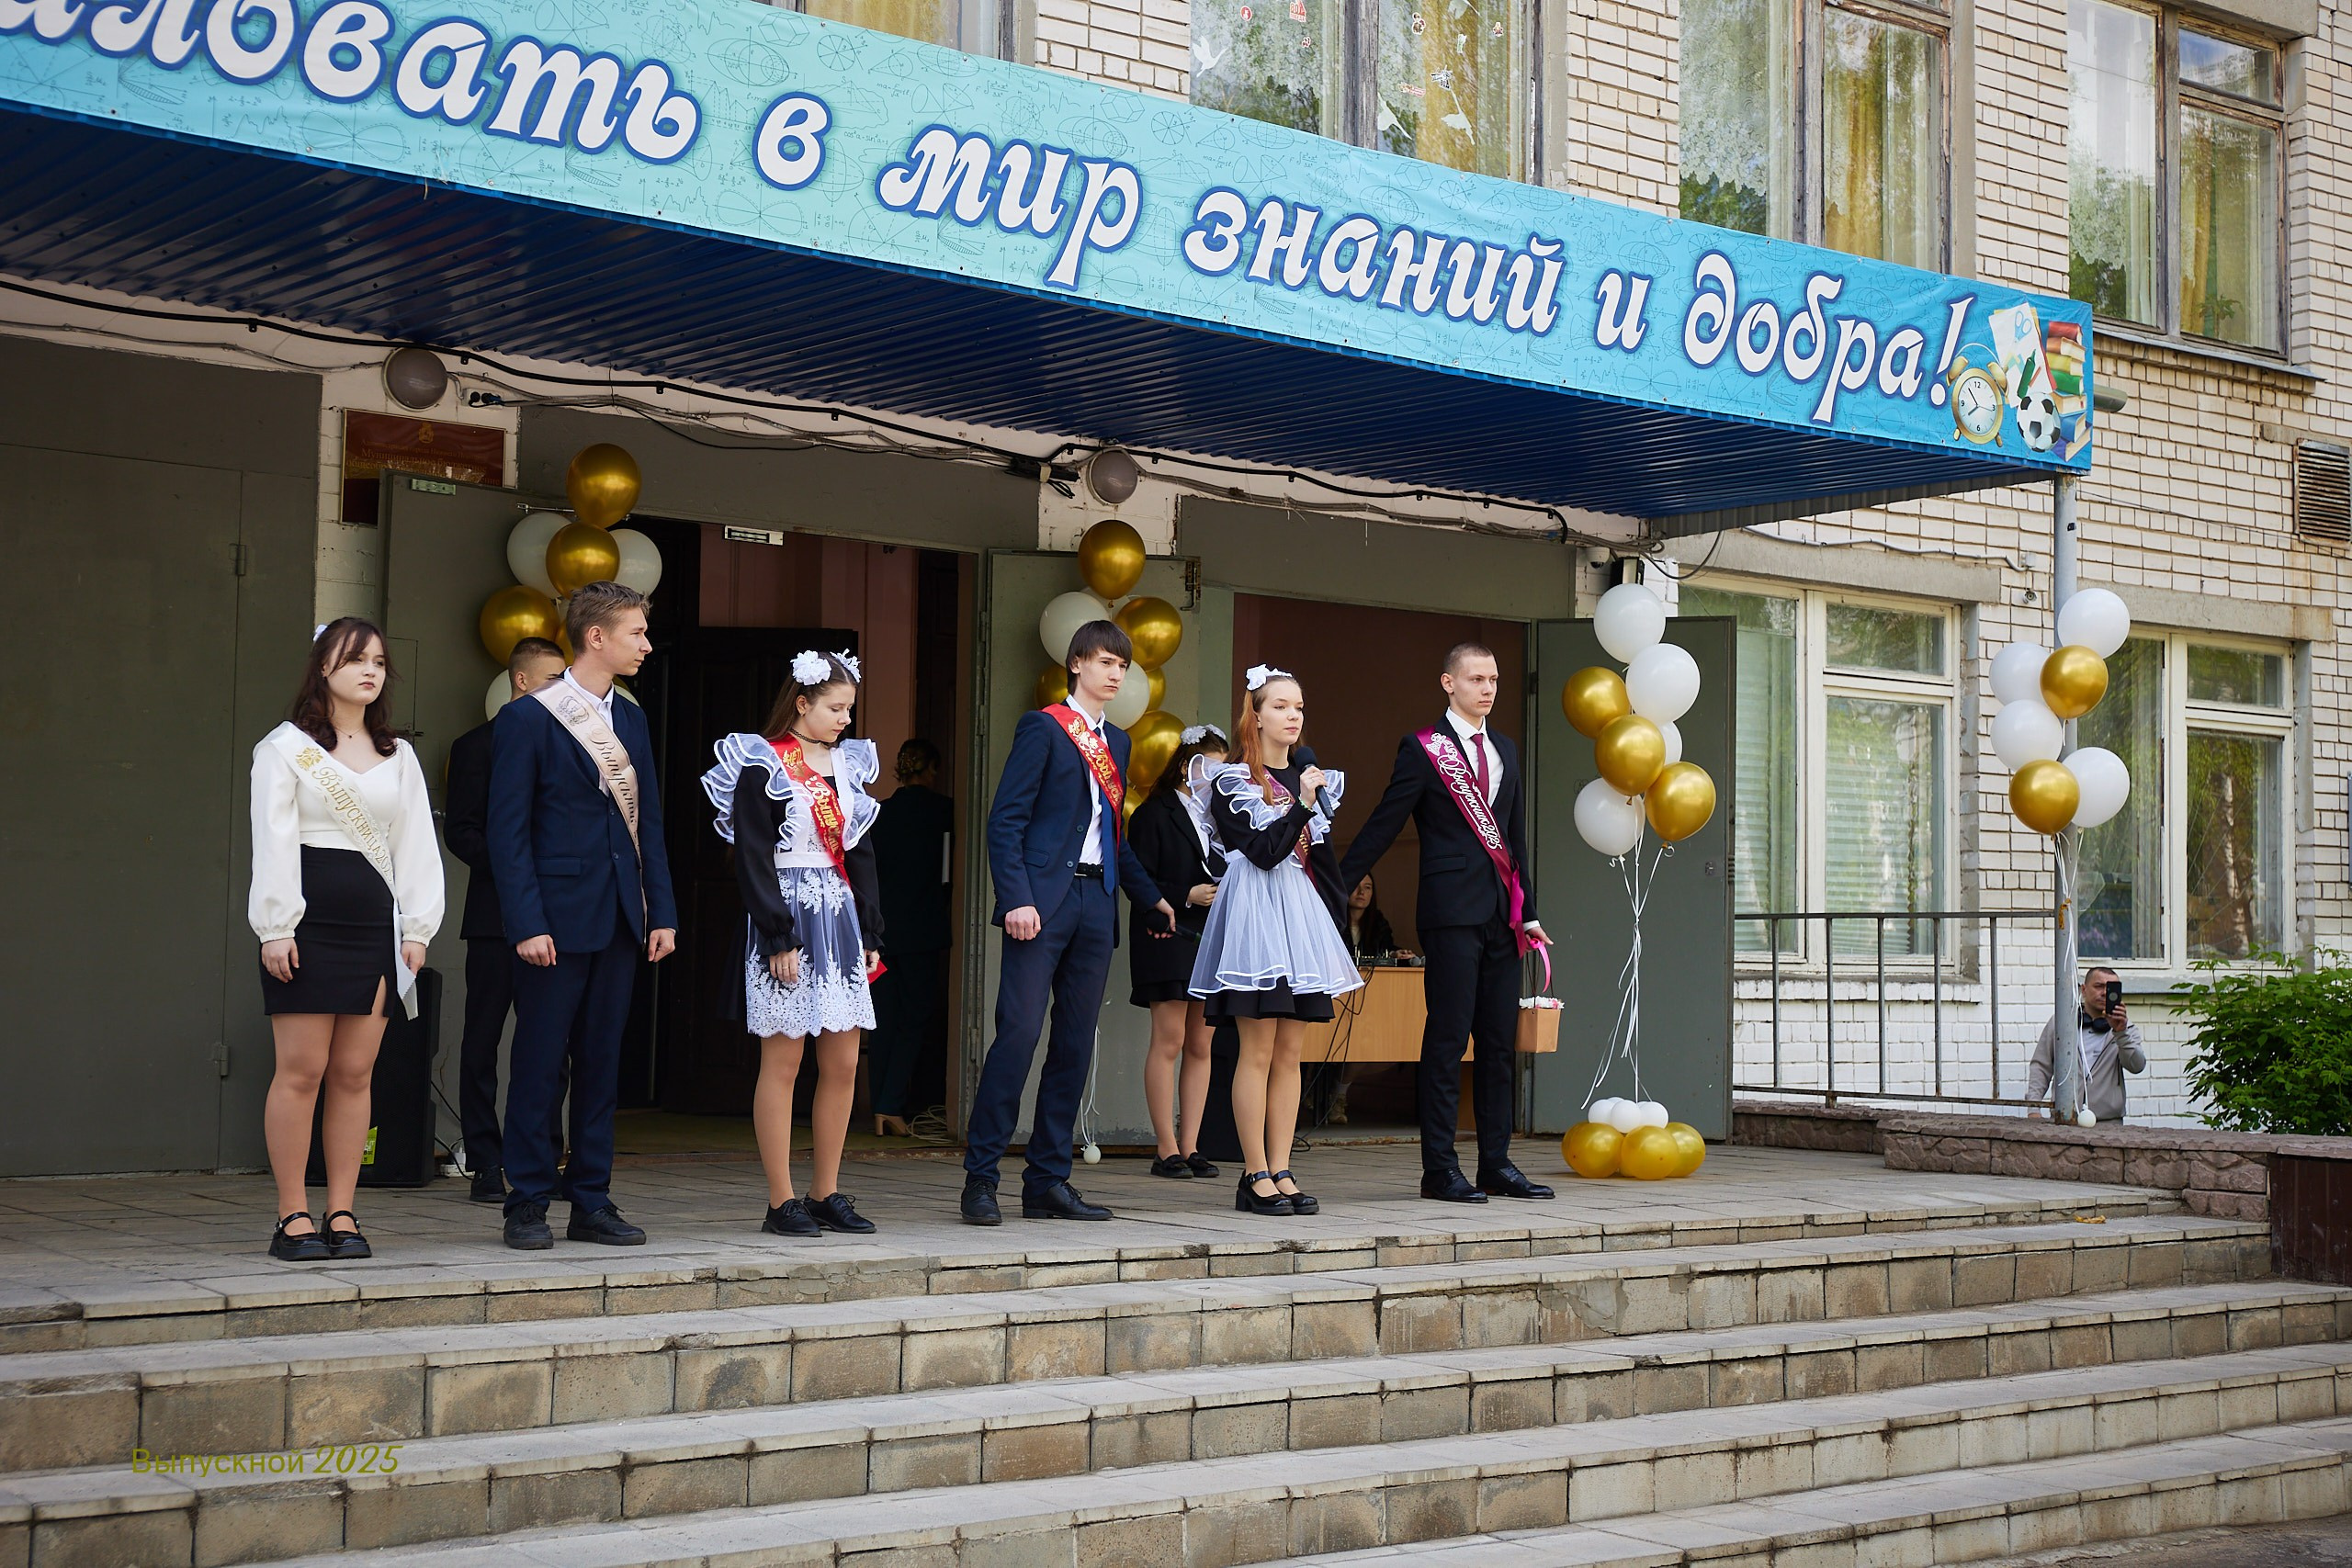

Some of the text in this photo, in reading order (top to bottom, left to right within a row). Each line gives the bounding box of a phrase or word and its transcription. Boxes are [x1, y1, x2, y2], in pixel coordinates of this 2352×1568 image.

[754, 94, 830, 188] в
[876, 126, 1142, 290] мир
[1182, 187, 1565, 336] знаний
[1594, 269, 1653, 353] и
[1681, 250, 1976, 425] добра!
[1973, 380, 1982, 389] 12
